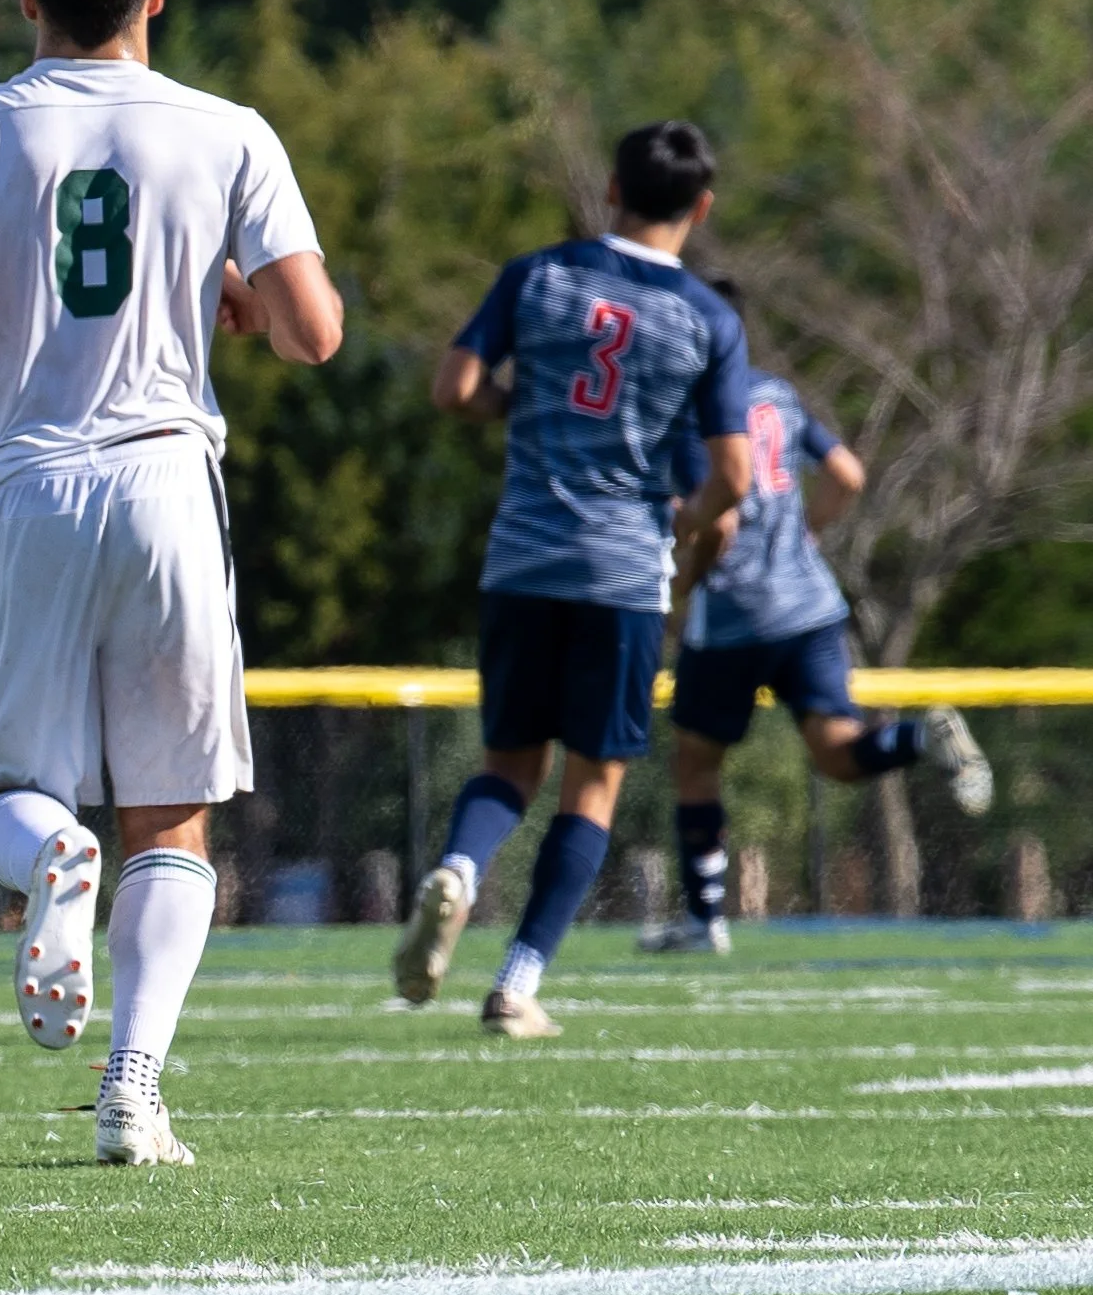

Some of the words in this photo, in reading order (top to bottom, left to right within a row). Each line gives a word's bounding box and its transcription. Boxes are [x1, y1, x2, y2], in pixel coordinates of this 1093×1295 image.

[55, 167, 133, 319] 8
[568, 298, 637, 419] 3
[109, 1108, 136, 1120] new
